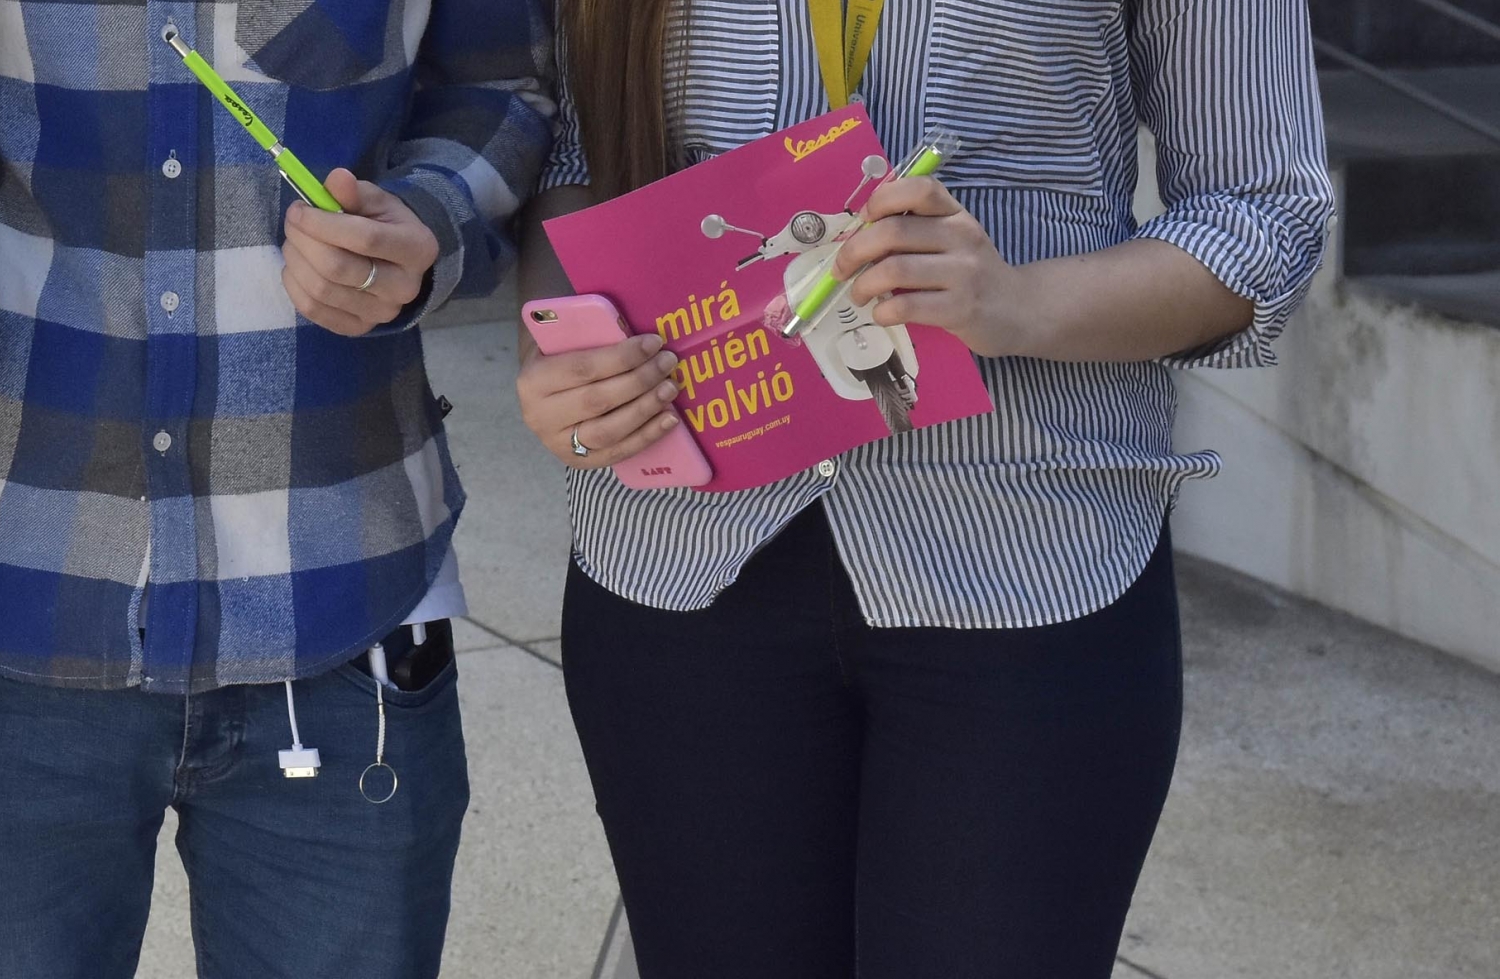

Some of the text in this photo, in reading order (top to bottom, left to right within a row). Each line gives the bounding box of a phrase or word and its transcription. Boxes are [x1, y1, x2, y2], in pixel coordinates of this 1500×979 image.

[224, 93, 254, 127] Vespa
[784, 117, 862, 163] Vespa
[655, 280, 741, 345] mirá
[670, 328, 771, 401] quién
[684, 362, 795, 433] volvió
[715, 414, 791, 449] vespauruguay.com.uy
